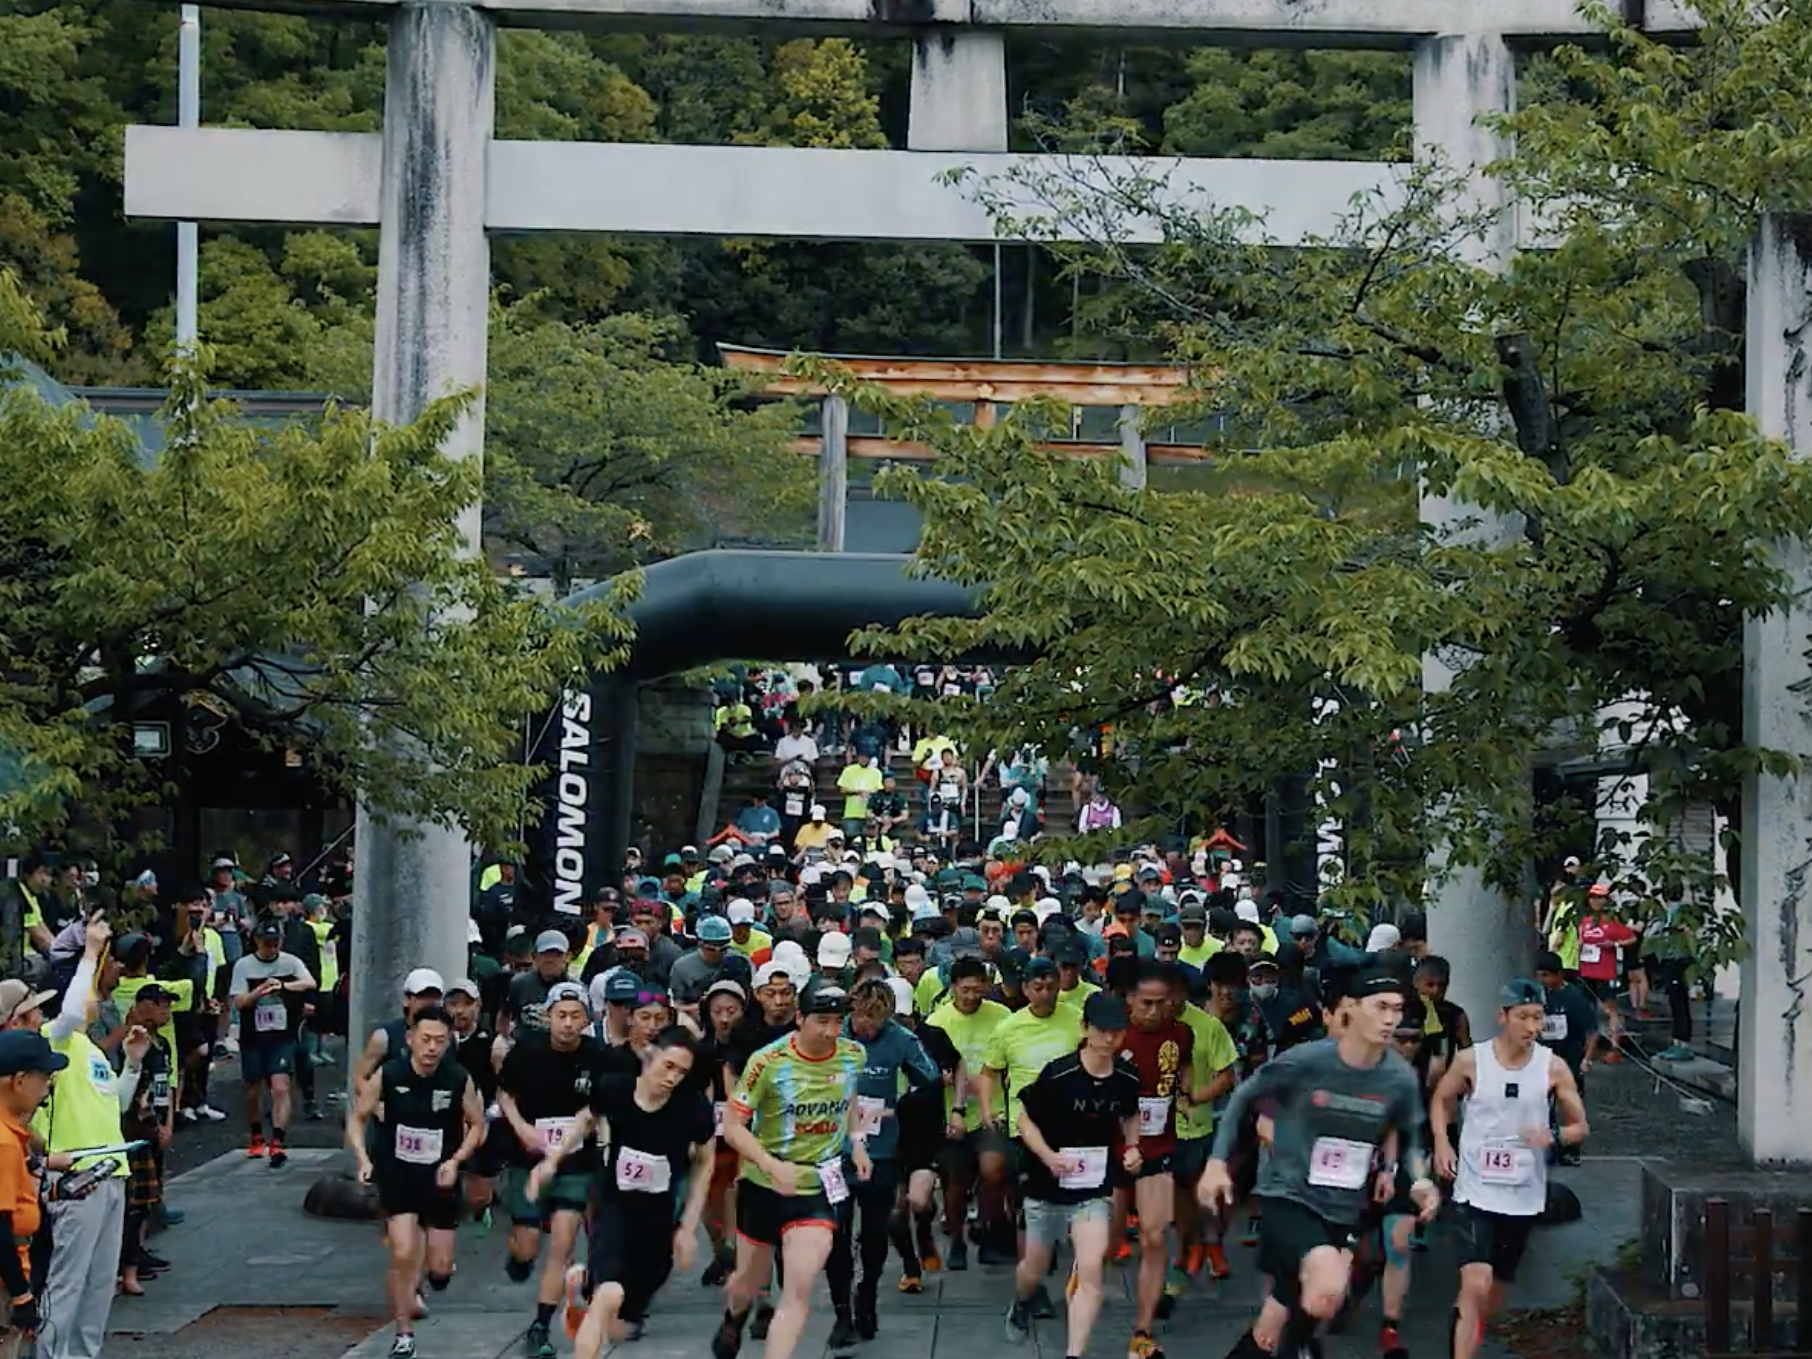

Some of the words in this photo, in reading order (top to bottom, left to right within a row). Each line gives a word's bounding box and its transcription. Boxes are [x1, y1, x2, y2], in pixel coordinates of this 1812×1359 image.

[554, 688, 592, 915] SALOMON
[1486, 1152, 1511, 1168] 143
[624, 1162, 645, 1179] 52
